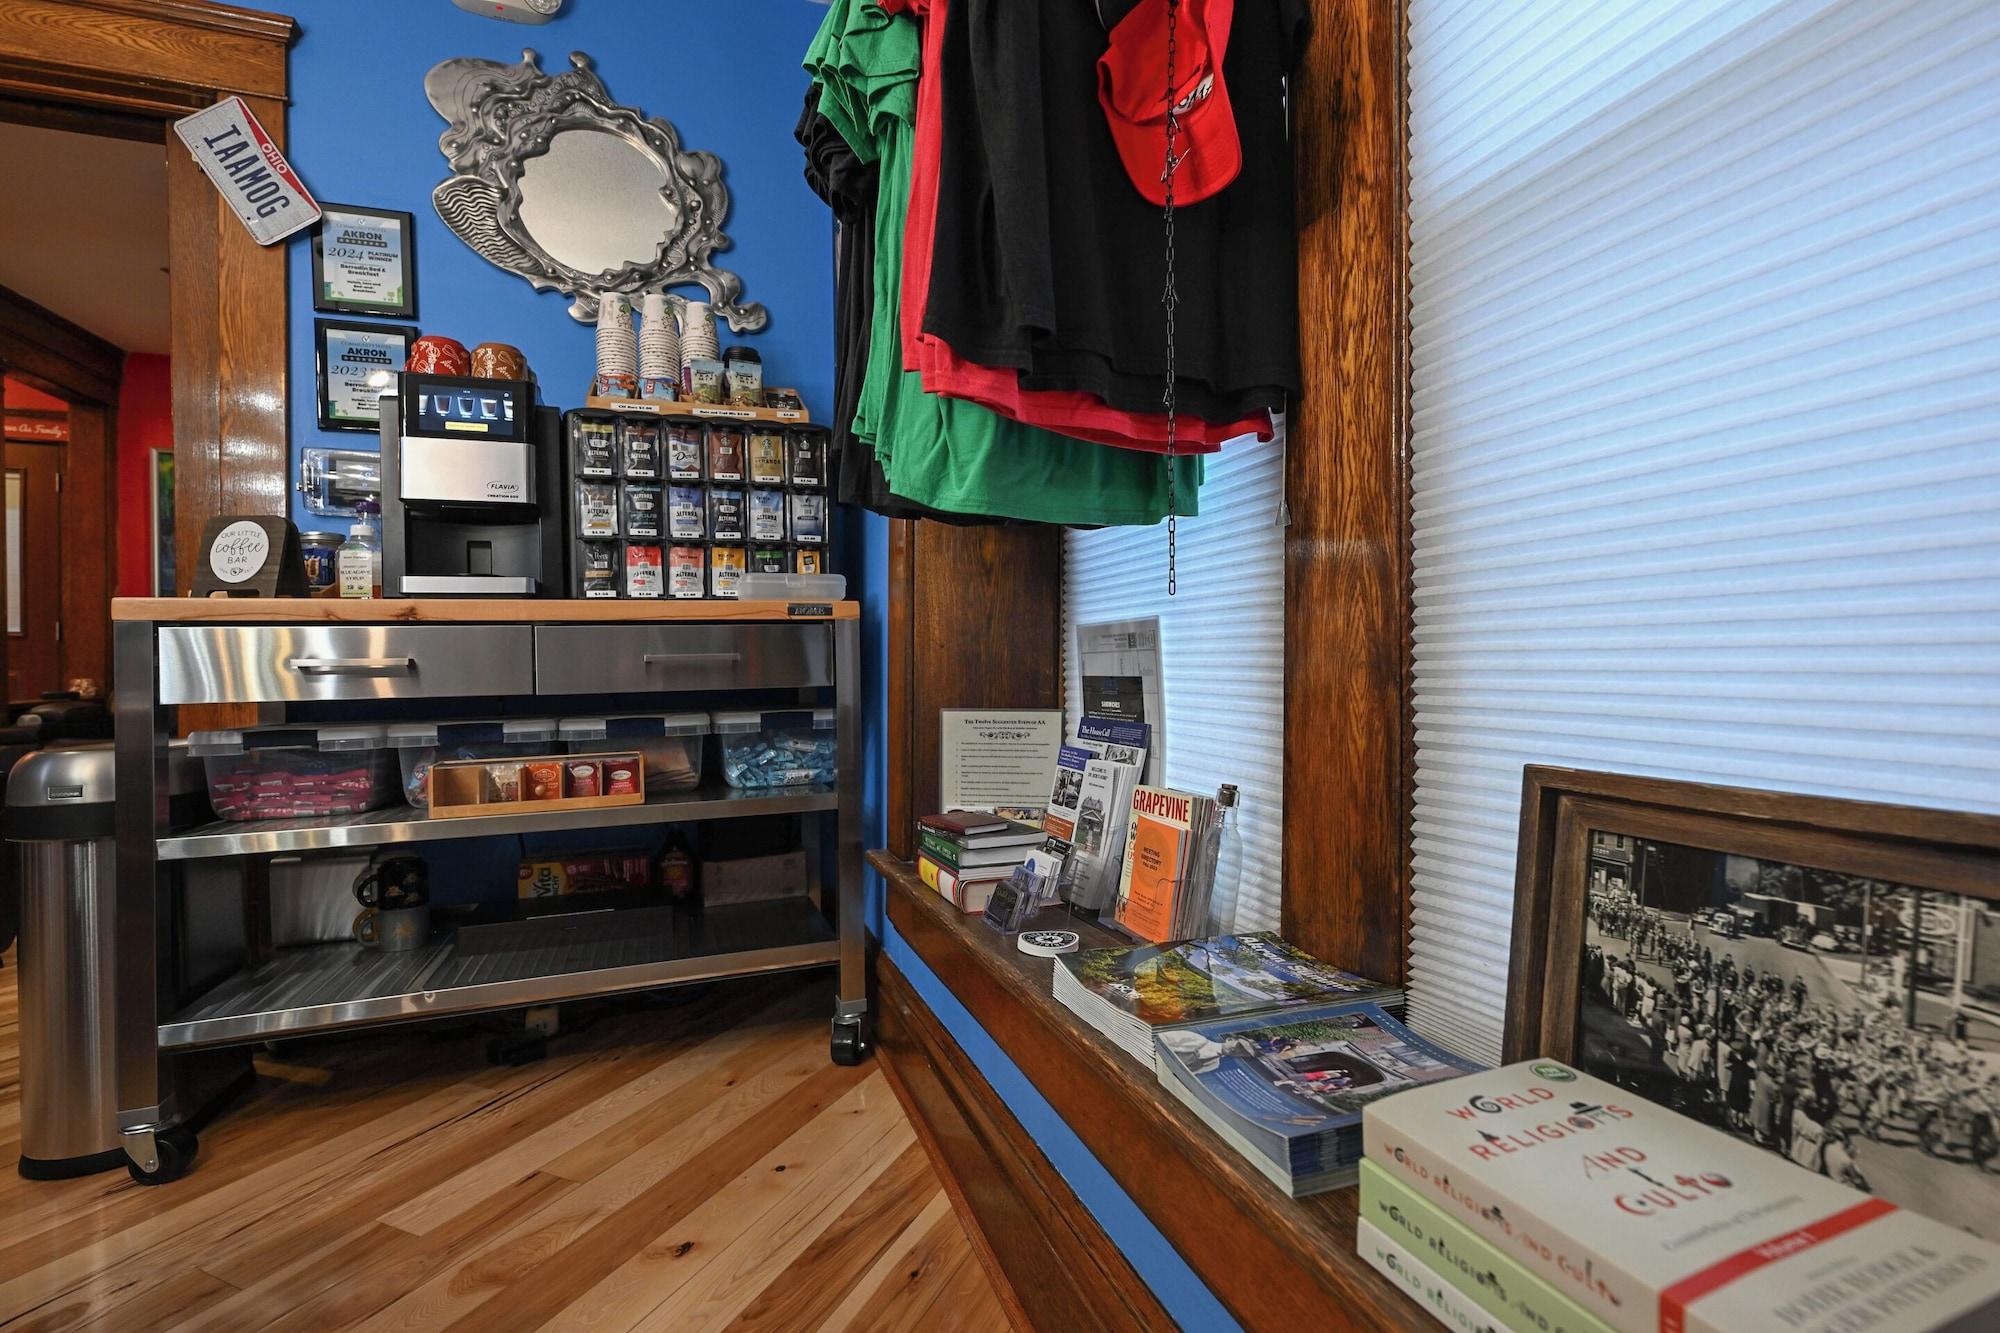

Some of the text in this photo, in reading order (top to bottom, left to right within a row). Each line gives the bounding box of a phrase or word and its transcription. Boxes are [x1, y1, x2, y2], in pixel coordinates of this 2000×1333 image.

[203, 124, 290, 218] IAAMOG
[261, 142, 287, 174] OHIO
[342, 230, 382, 240] AKRON
[328, 246, 364, 261] 2024
[347, 347, 387, 357] AKRON
[330, 365, 368, 378] 2023
[216, 538, 264, 556] coffee
[238, 530, 262, 538] LITTLE
[228, 556, 248, 564] BAR
[1133, 788, 1190, 823] GRAPEVINE
[1239, 936, 1287, 963] Akron
[1445, 1086, 1556, 1122] WORLD
[1383, 1143, 1429, 1179] WORLD
[1582, 1146, 1647, 1180] AND
[1378, 1199, 1424, 1240] WORLD
[1374, 1247, 1422, 1291] WORLD
